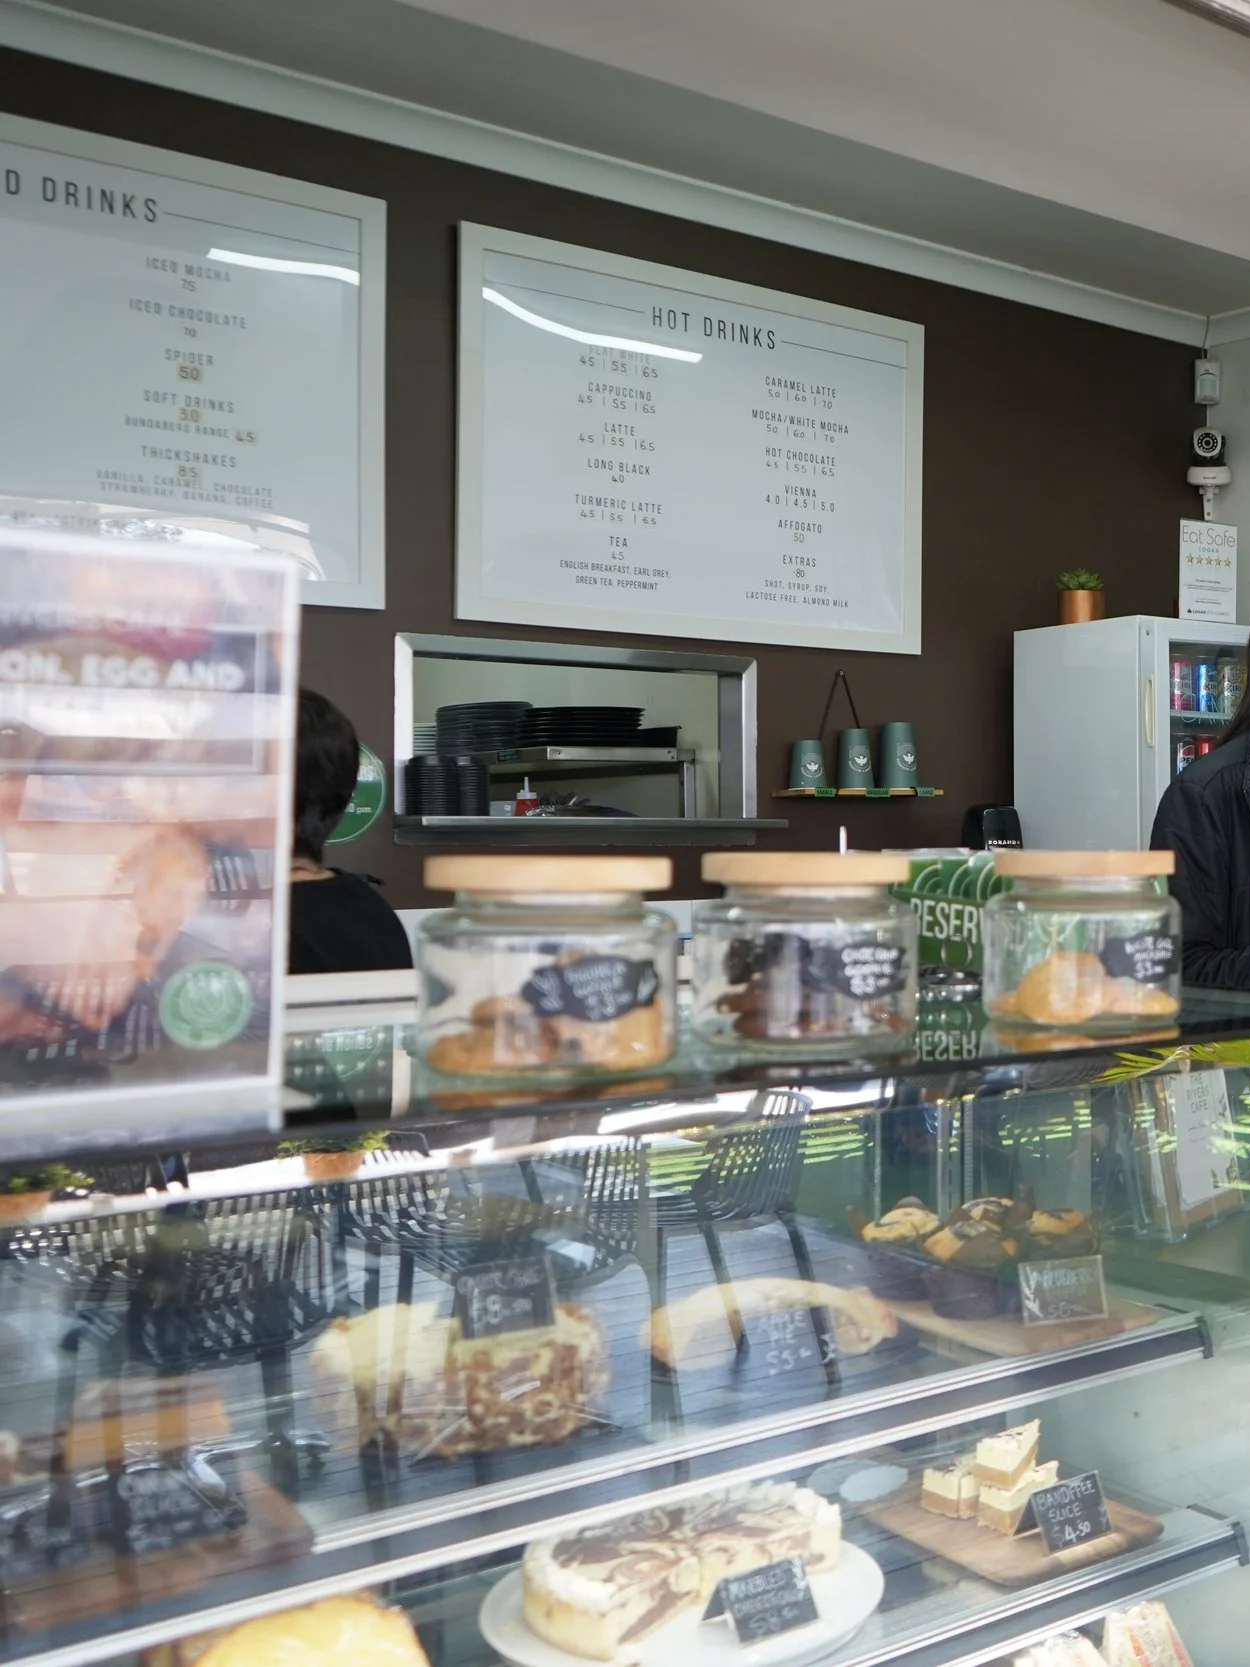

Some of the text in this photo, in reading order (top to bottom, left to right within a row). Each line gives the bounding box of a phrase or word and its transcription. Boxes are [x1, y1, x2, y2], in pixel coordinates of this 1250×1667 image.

[42, 175, 159, 223] DRINKS
[146, 256, 231, 283] ICED MOCHA
[129, 298, 247, 330] ICED CHOCOLATE
[652, 306, 777, 351] HOT DRINKS
[164, 349, 214, 366] SPIDER
[588, 381, 652, 402] CAPPUCCINO
[765, 376, 836, 399] CARAMEL LATTE
[143, 389, 234, 413] SOFT DRINKS
[194, 424, 229, 439] RANGE
[604, 422, 636, 437] LATTE
[752, 409, 849, 435] MOCHA/WHITE MOCHA
[141, 445, 237, 468] THICKSHAKES
[587, 458, 650, 475] LONG BLACK
[765, 446, 836, 467] HOT CHOCOLATE
[785, 484, 817, 498] VIENNA
[575, 494, 662, 515] TURMERIC LATTE
[778, 519, 822, 534] AFFOGATO
[1182, 525, 1236, 548] Eat Safe
[609, 536, 628, 548] TEA
[560, 560, 589, 570] ENGLISH
[634, 566, 650, 577] EARL
[782, 554, 817, 568] EXTRAS
[575, 575, 598, 585] GREEN
[617, 579, 658, 591] PEPPERMINT
[746, 591, 777, 602] LACTOSE
[803, 596, 830, 607] ALMOND
[833, 599, 849, 608] MILK
[81, 652, 159, 688] EGG
[165, 658, 246, 692] AND
[1191, 1074, 1203, 1085] THE
[1186, 1086, 1209, 1100] RIVERS
[1191, 1101, 1209, 1114] CAFE
[1036, 1480, 1096, 1511] BANOFFEE
[1048, 1502, 1081, 1523] SLICE
